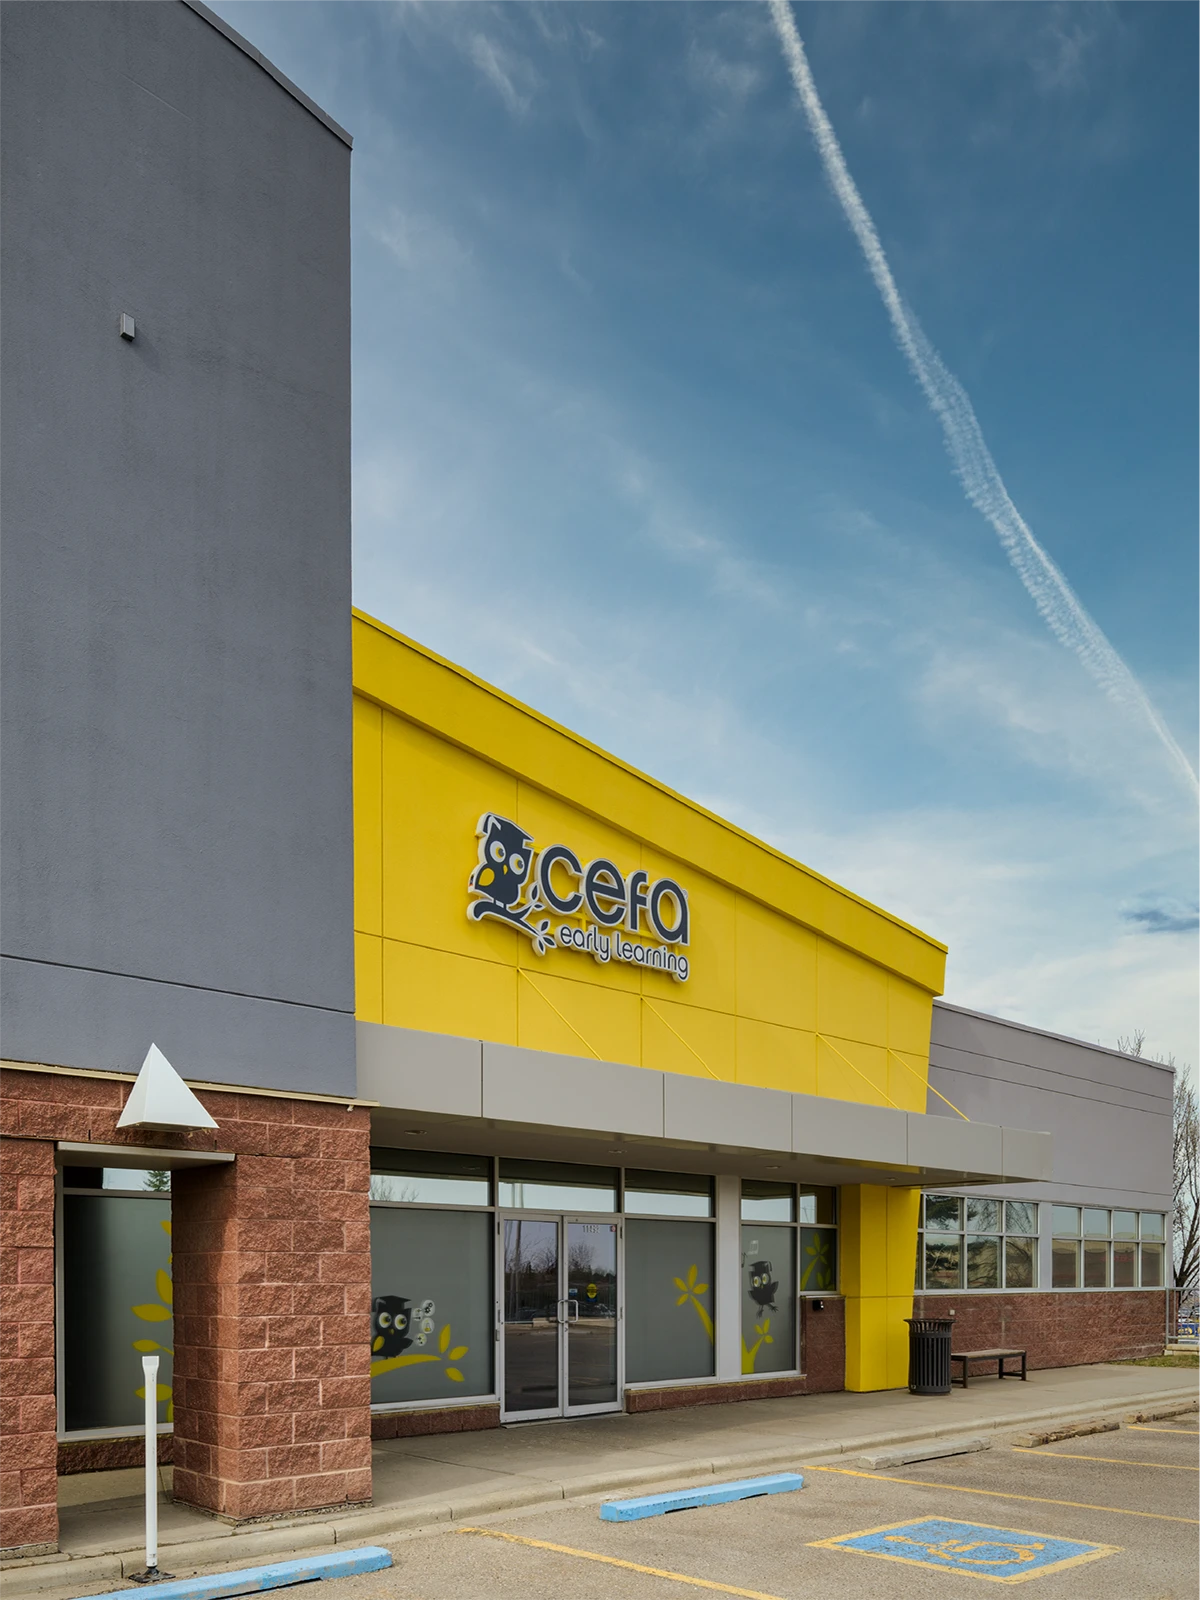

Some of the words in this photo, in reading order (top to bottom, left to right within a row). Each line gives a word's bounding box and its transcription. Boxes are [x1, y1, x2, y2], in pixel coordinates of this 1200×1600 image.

[538, 845, 690, 945] cefa
[558, 925, 610, 962] early
[615, 932, 689, 981] learning
